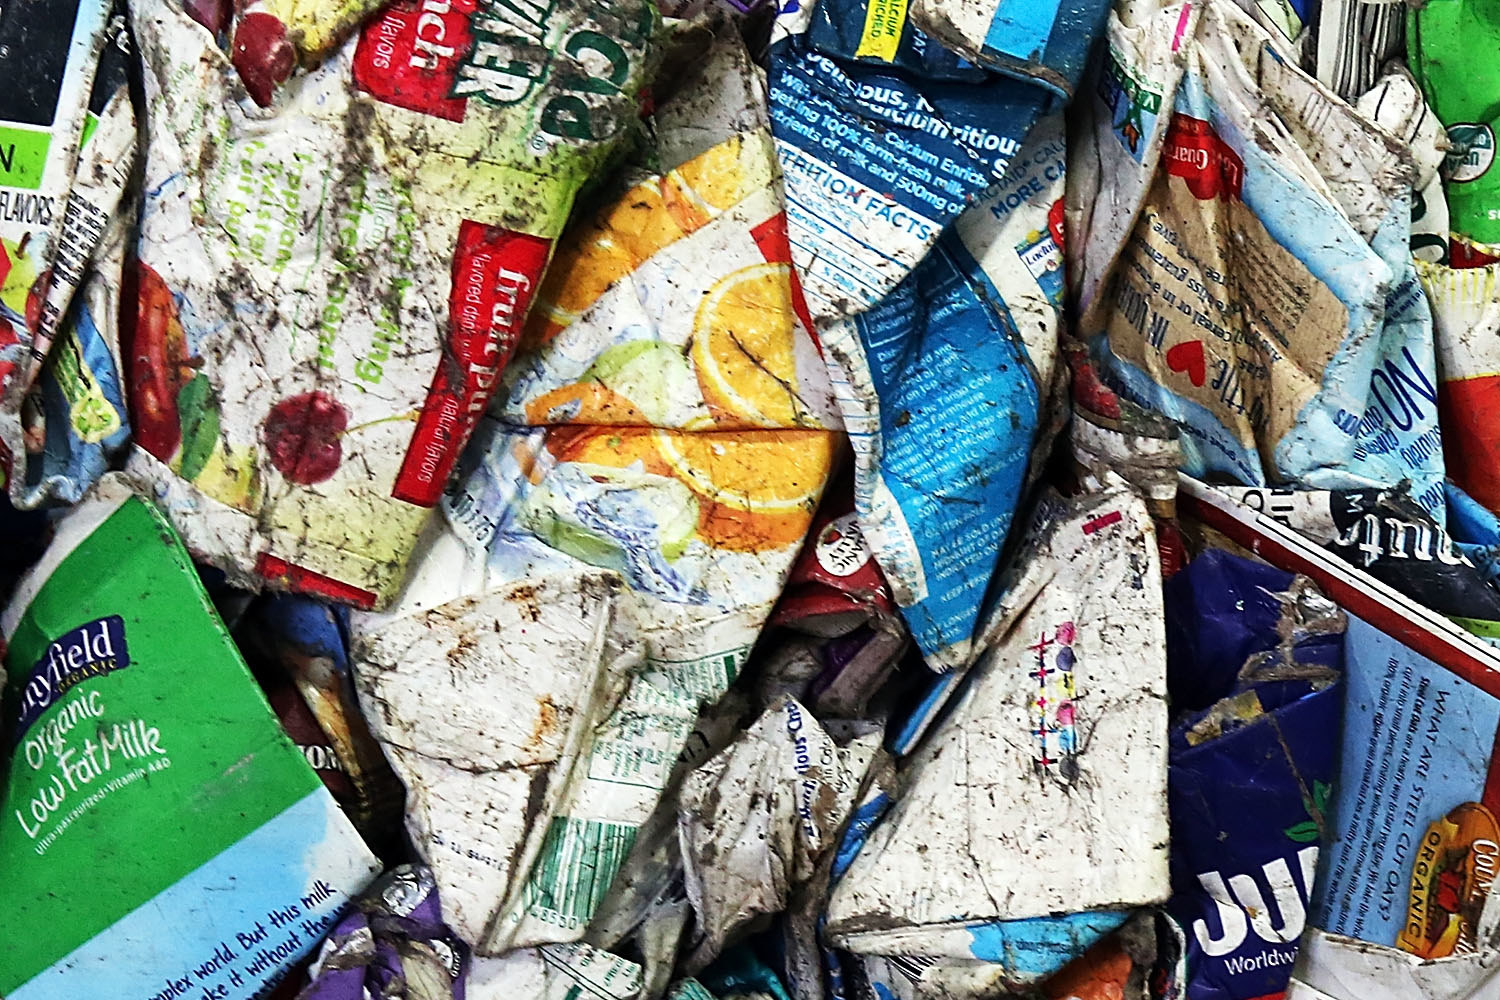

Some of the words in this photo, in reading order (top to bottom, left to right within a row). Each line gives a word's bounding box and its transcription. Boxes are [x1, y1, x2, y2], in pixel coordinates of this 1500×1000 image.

[868, 154, 899, 186] and
[864, 192, 934, 242] FACTS
[25, 688, 106, 771] Organic
[1424, 690, 1451, 744] WHAT
[15, 777, 66, 840] Low
[58, 741, 104, 800] Fat
[99, 719, 168, 774] Milk
[1415, 749, 1434, 780] ARE
[1401, 784, 1425, 829] STEEL
[1391, 832, 1413, 867] CUT
[1375, 870, 1401, 922] OATS?
[1408, 831, 1441, 936] ORGANIC
[194, 941, 235, 980] world.
[236, 921, 268, 951] But
[268, 904, 301, 929] this
[301, 880, 337, 910] milk
[245, 930, 302, 977] without
